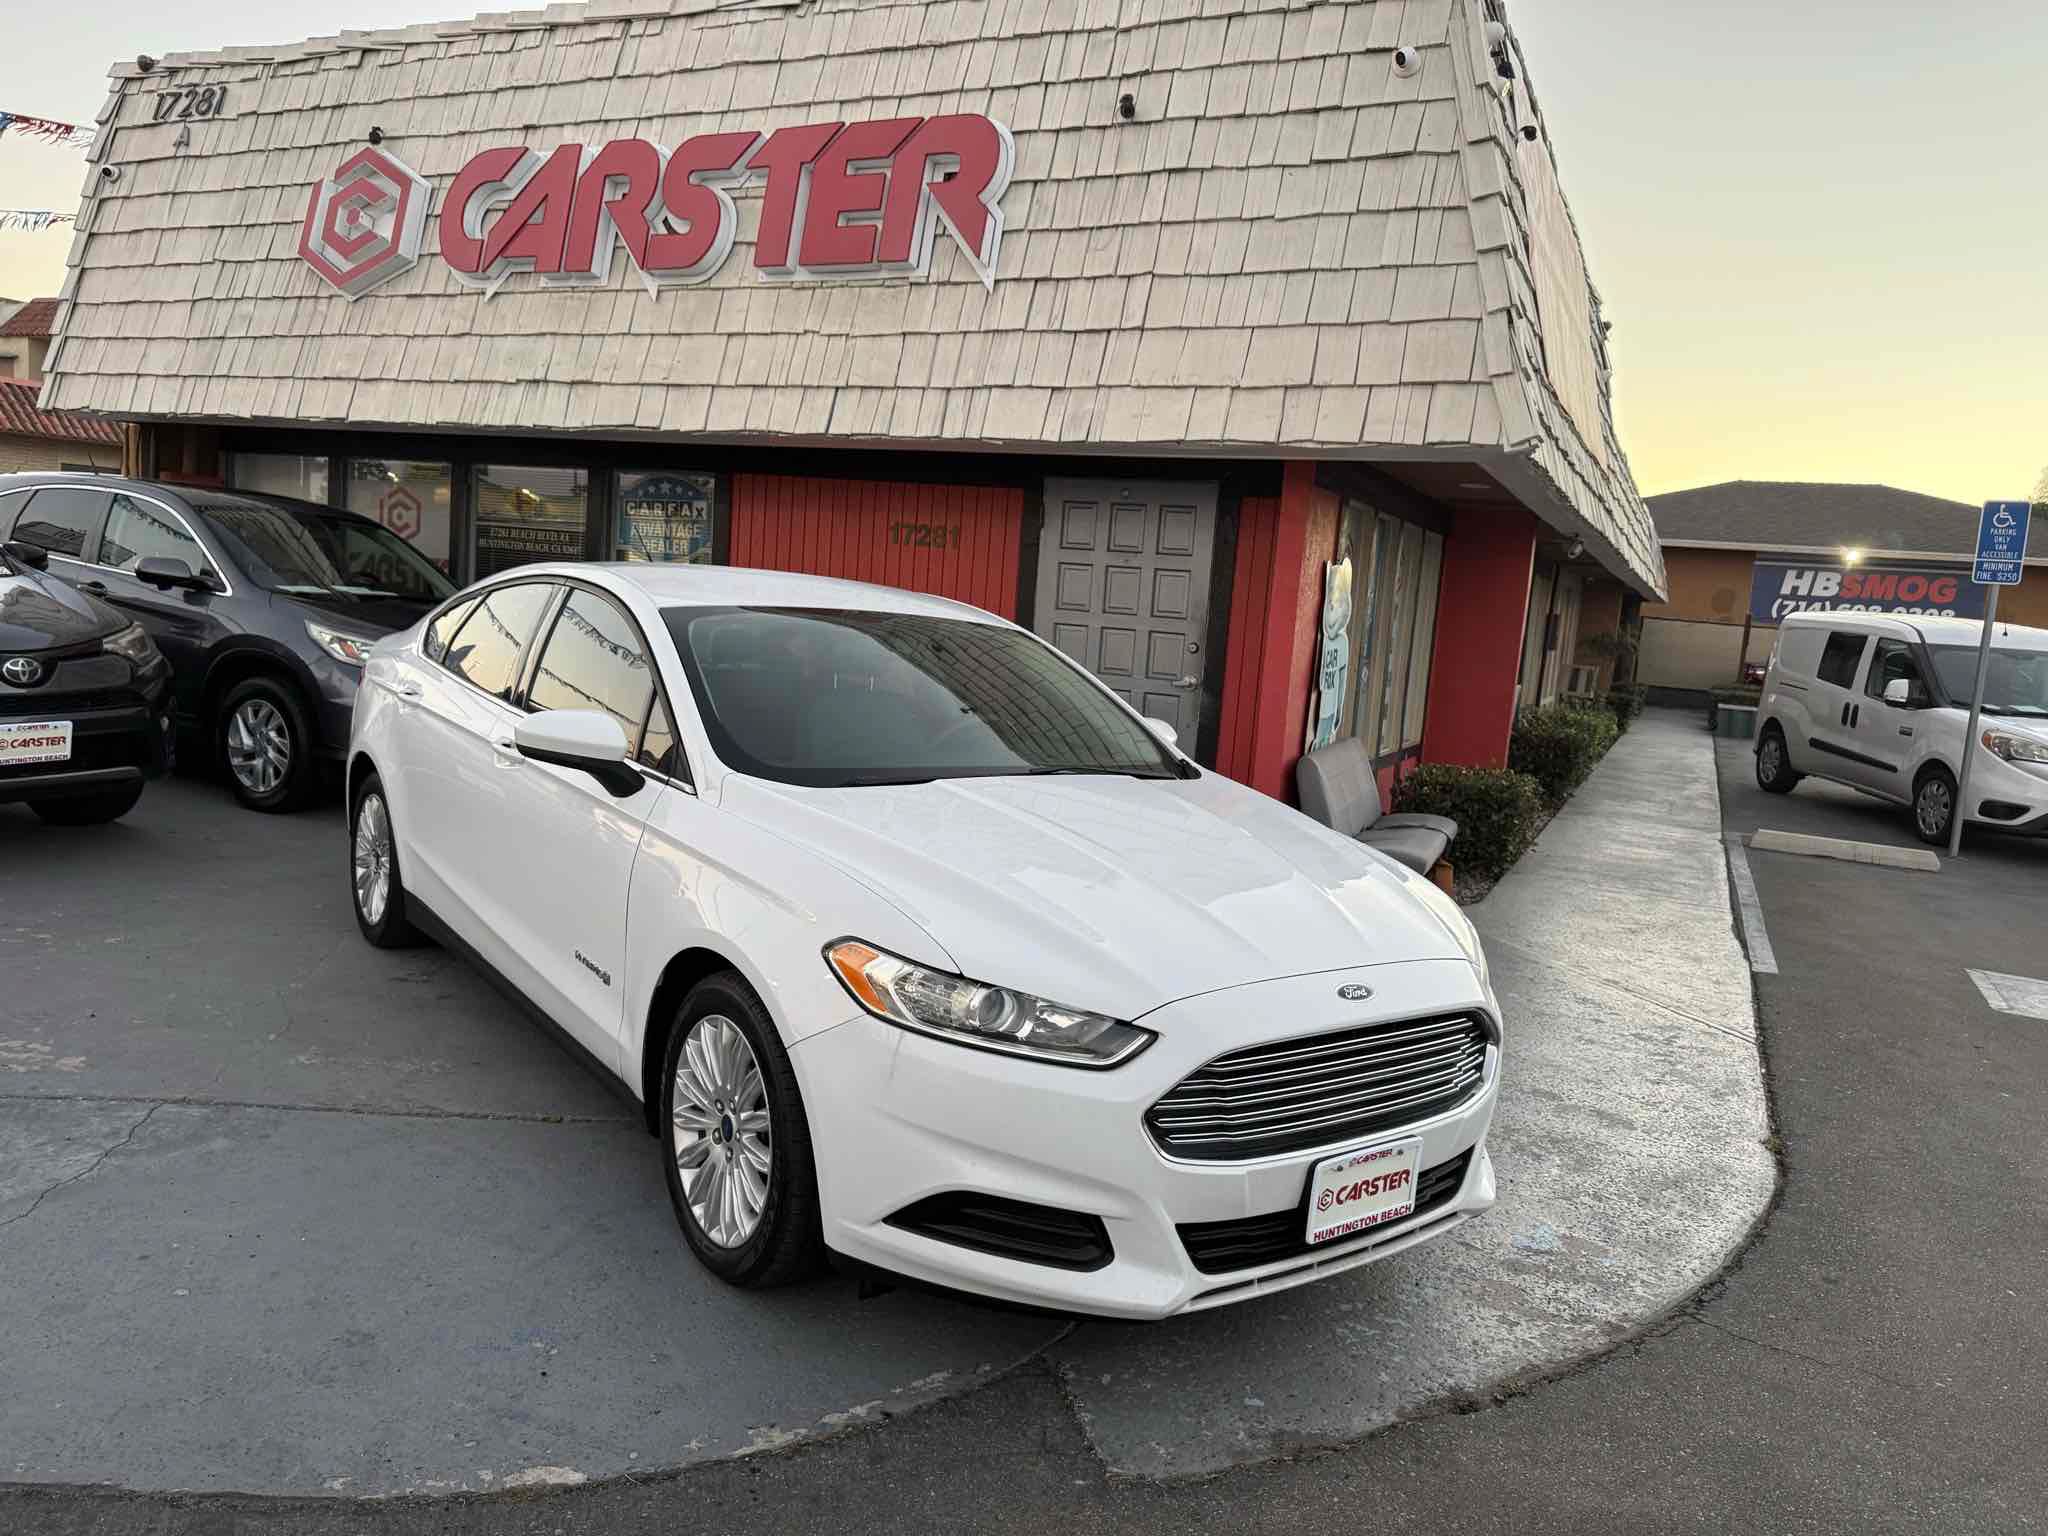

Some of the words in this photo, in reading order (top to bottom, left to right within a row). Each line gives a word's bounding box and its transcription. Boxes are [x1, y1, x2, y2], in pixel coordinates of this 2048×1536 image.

[152, 86, 227, 121] 17281
[440, 113, 1016, 302] CARSTER
[626, 500, 706, 520] CARFAX
[630, 521, 704, 538] ADVANTAGE
[889, 521, 960, 552] 17281
[1990, 527, 2017, 536] PARKING
[640, 539, 689, 555] DEALER
[1994, 535, 2011, 544] ONLY
[1995, 543, 2008, 551] VAN
[1981, 550, 2019, 559] ACCESSIBLE
[1982, 561, 2014, 572] MINIMUM
[1976, 570, 1993, 580] FINE
[1997, 571, 2018, 582] $250
[1325, 647, 1338, 670] CAR
[11, 736, 66, 749] CARSTER
[1344, 985, 1368, 999] Ford
[1357, 1148, 1393, 1164] CARSTER
[1335, 1168, 1410, 1205] CARSTER
[1313, 1213, 1379, 1242] HUNTINGTON
[1380, 1203, 1412, 1222] BEACH
